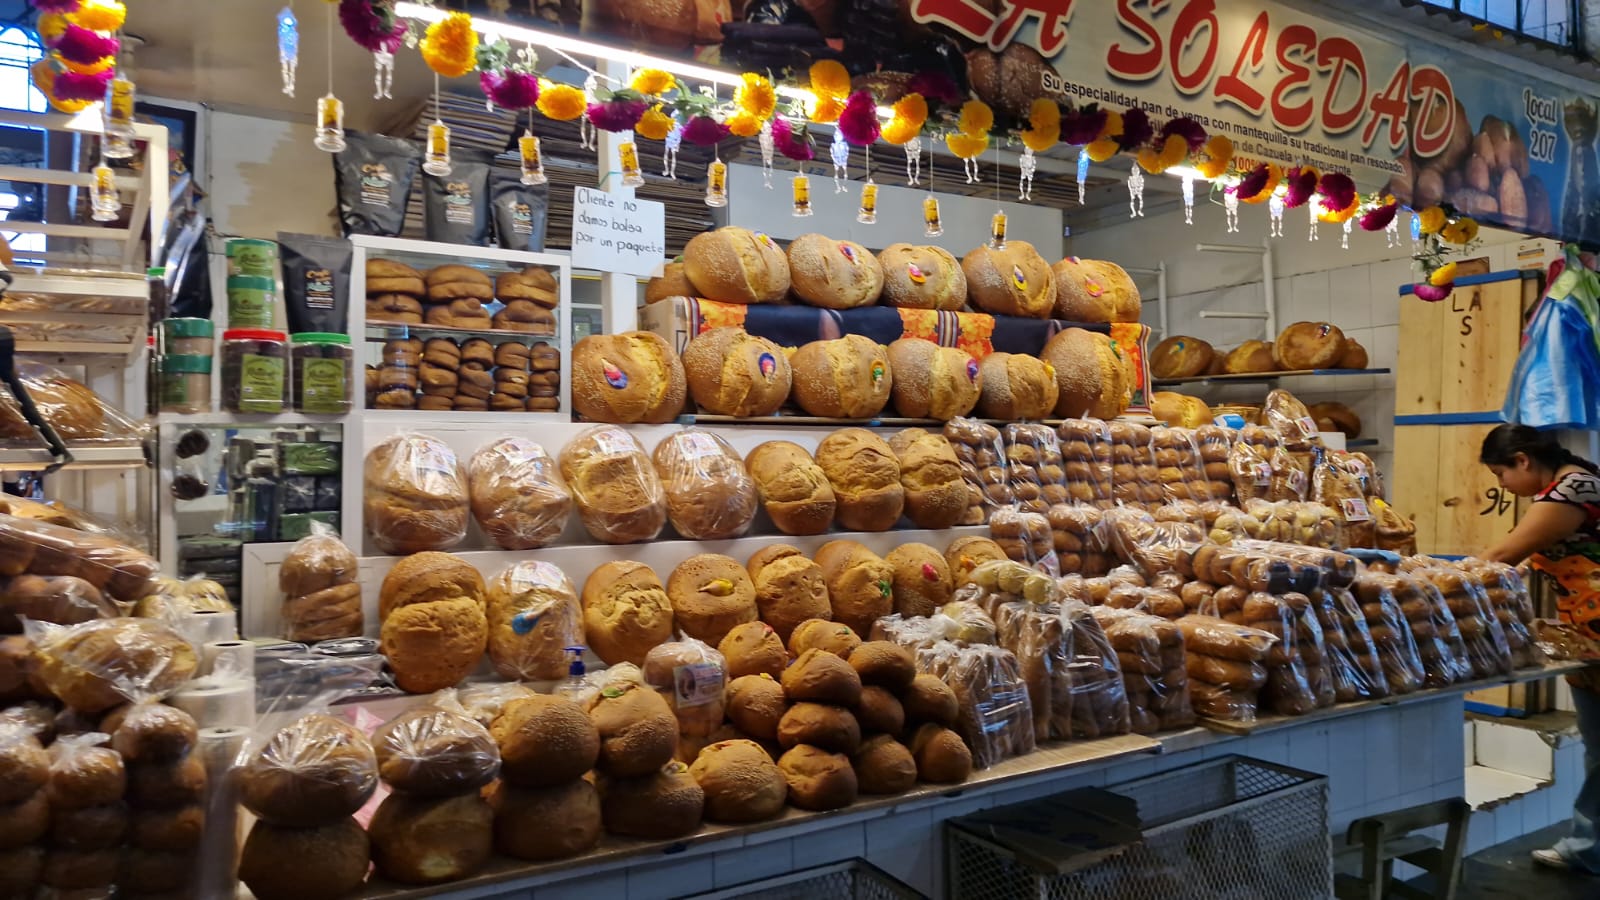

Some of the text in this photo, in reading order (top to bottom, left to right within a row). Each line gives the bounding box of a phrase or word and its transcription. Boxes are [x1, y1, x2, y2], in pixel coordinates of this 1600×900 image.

[1105, 0, 1456, 155] SOLEDAD
[1524, 89, 1556, 124] Local
[1043, 73, 1060, 90] Su
[1064, 81, 1138, 109] especialidad
[1141, 101, 1162, 114] pan
[1165, 104, 1178, 118] de
[1212, 116, 1231, 130] con
[1233, 120, 1288, 148] mantequilla
[1290, 138, 1301, 148] su
[1303, 140, 1348, 161] tradicional
[1350, 153, 1365, 166] pan
[1241, 140, 1254, 153] de
[1255, 143, 1293, 162] Cazuela
[1531, 130, 1555, 161] 207
[578, 188, 637, 212] Cliente no
[578, 210, 643, 233] damos bolsa
[576, 231, 664, 256] por un paquete
[1452, 292, 1482, 313] LA
[1460, 316, 1472, 336] S
